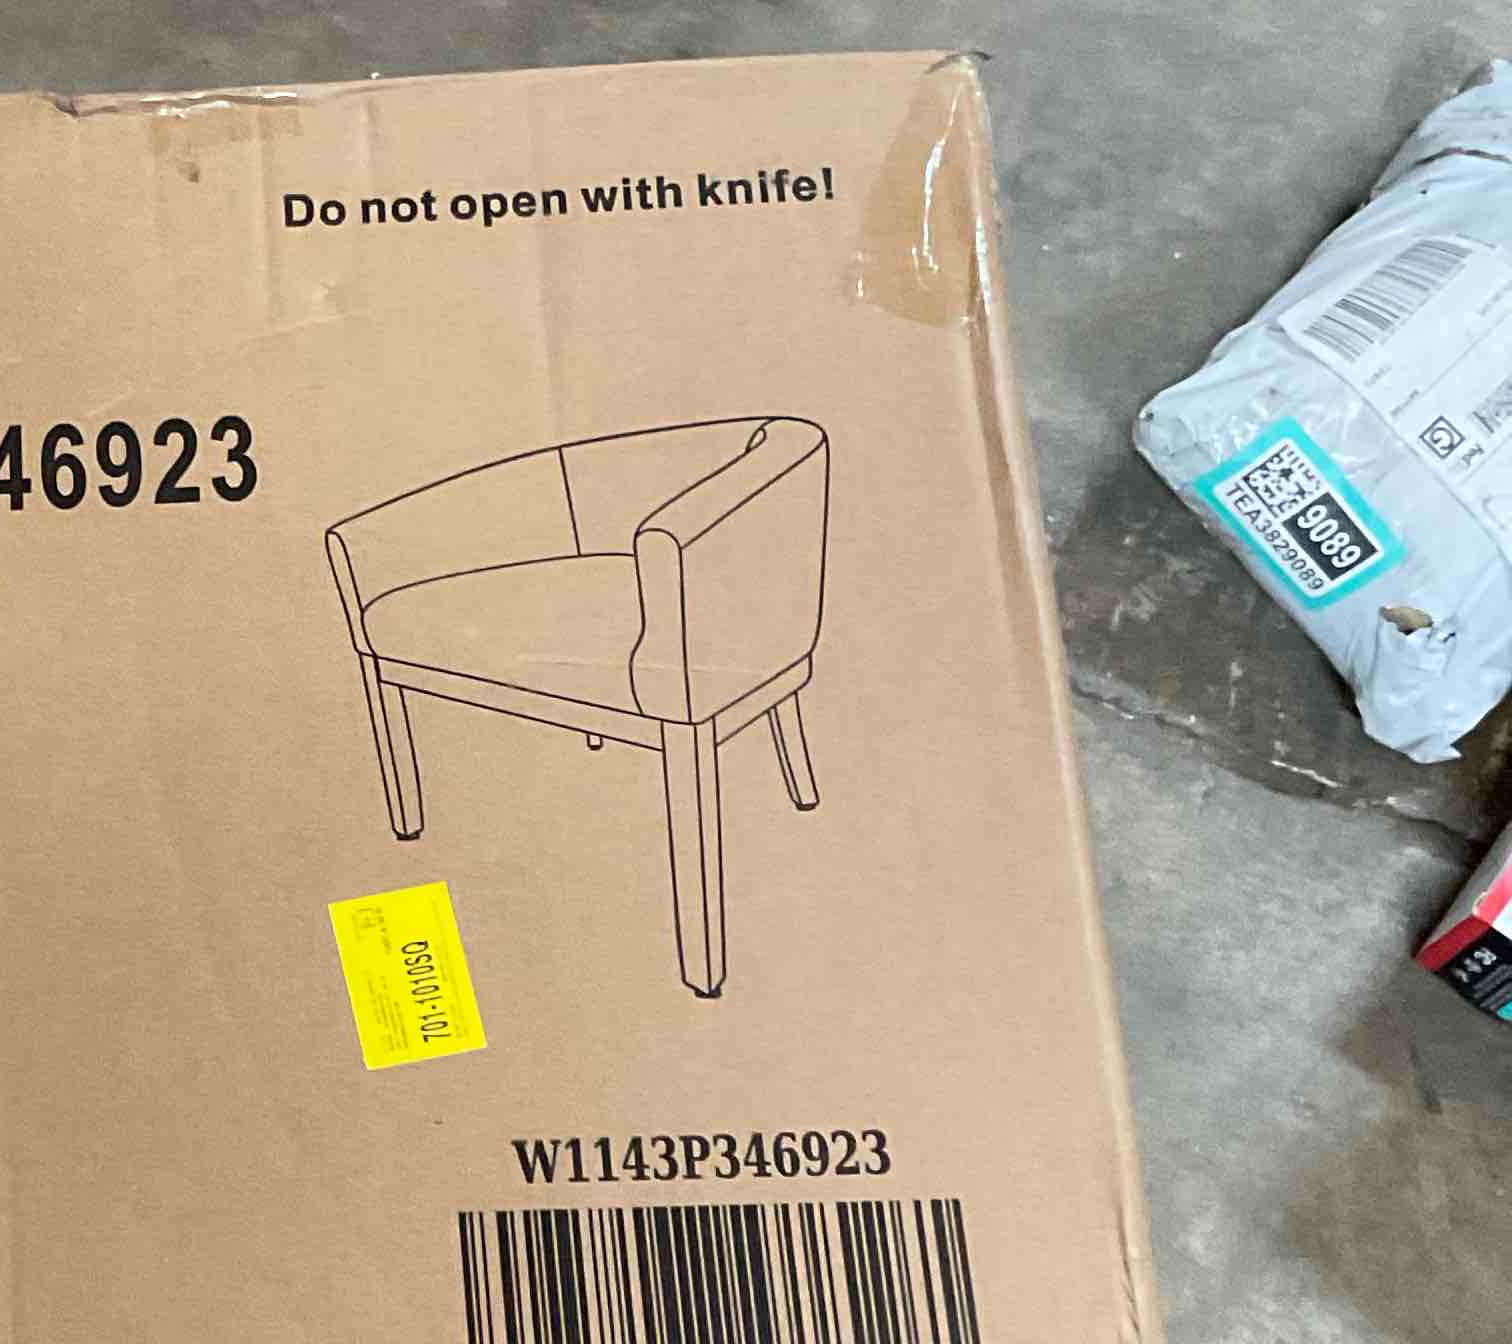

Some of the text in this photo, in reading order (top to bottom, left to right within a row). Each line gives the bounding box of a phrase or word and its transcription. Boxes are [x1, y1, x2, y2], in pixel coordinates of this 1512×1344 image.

[284, 168, 833, 227] Do not open with knife!
[1225, 482, 1325, 591] TEA3829089
[1297, 504, 1361, 568] 9089
[400, 940, 452, 1043] 701-1010SQ
[511, 1130, 890, 1184] W1143P346923
